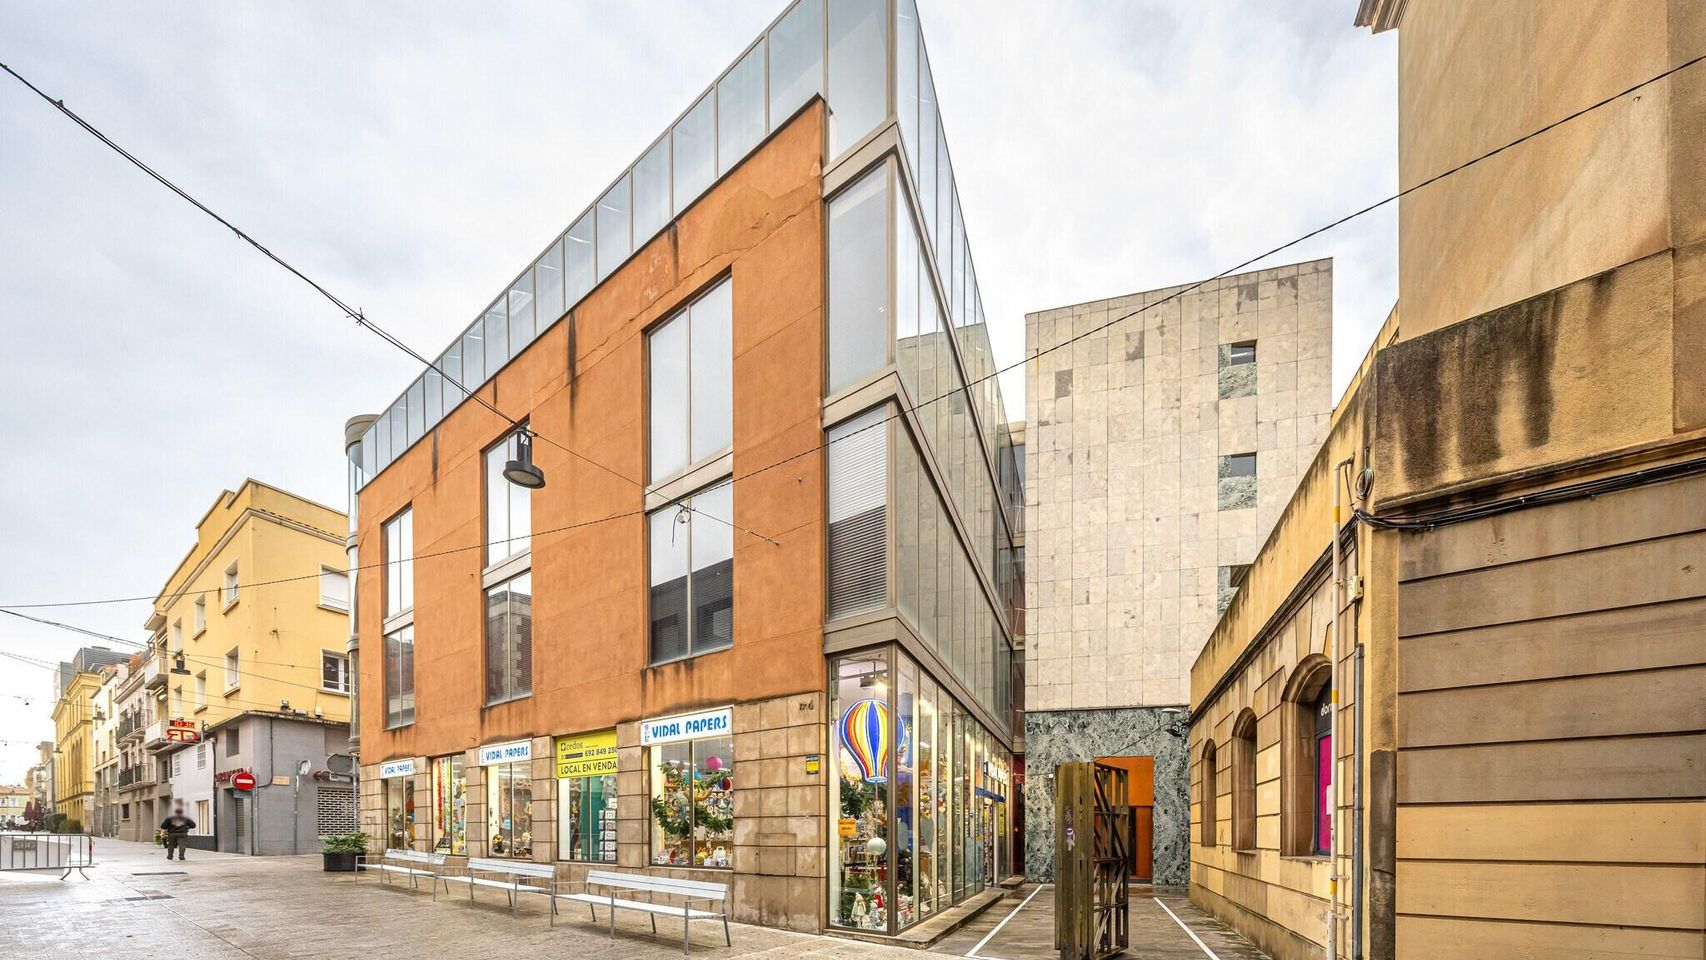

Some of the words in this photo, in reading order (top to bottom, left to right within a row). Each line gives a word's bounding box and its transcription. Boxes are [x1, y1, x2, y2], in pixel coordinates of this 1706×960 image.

[652, 723, 680, 738] VIDAL
[685, 715, 727, 734] PAPERS
[485, 750, 502, 760] VIDAL
[505, 746, 528, 758] PAPERS
[561, 765, 581, 774] LOCAL
[582, 763, 592, 772] EN
[593, 761, 617, 771] VENDA
